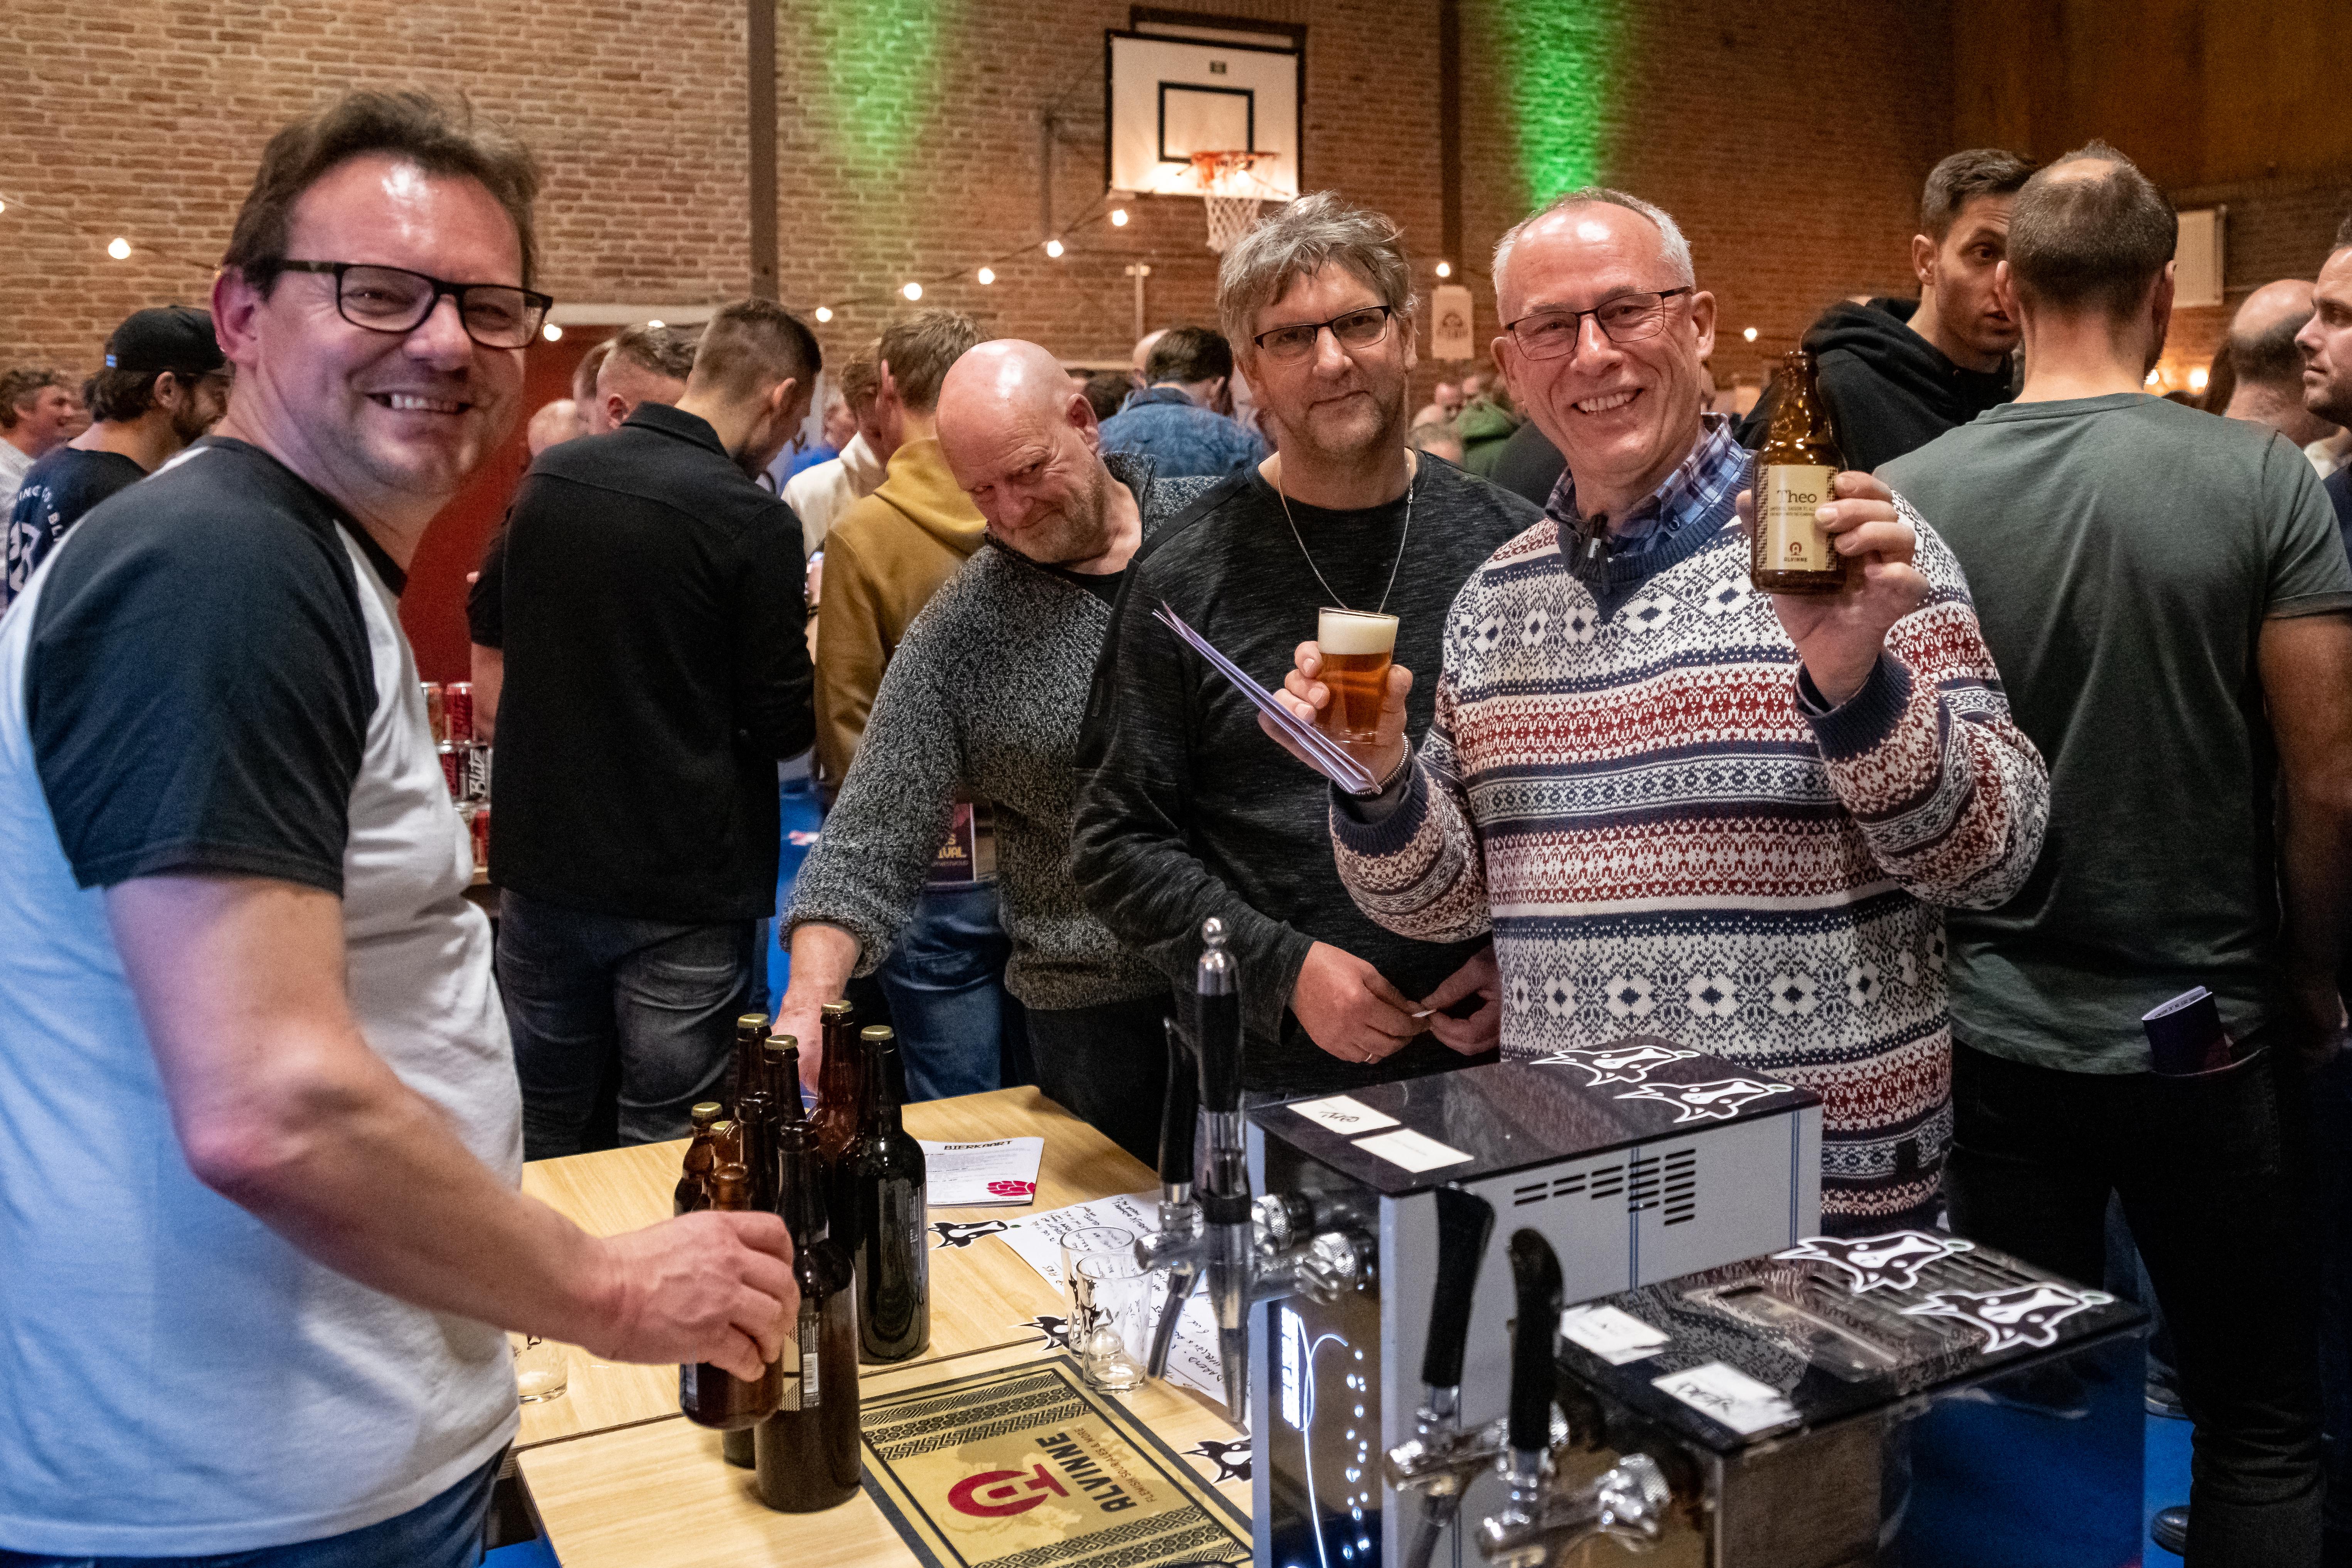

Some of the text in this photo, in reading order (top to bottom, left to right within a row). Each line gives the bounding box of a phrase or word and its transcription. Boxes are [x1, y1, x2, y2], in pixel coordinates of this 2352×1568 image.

[1776, 489, 1817, 504] Theo
[944, 1140, 1014, 1150] BIERKAART
[1035, 1432, 1138, 1513] ALVINNE
[1125, 1477, 1156, 1503] FLEMISH
